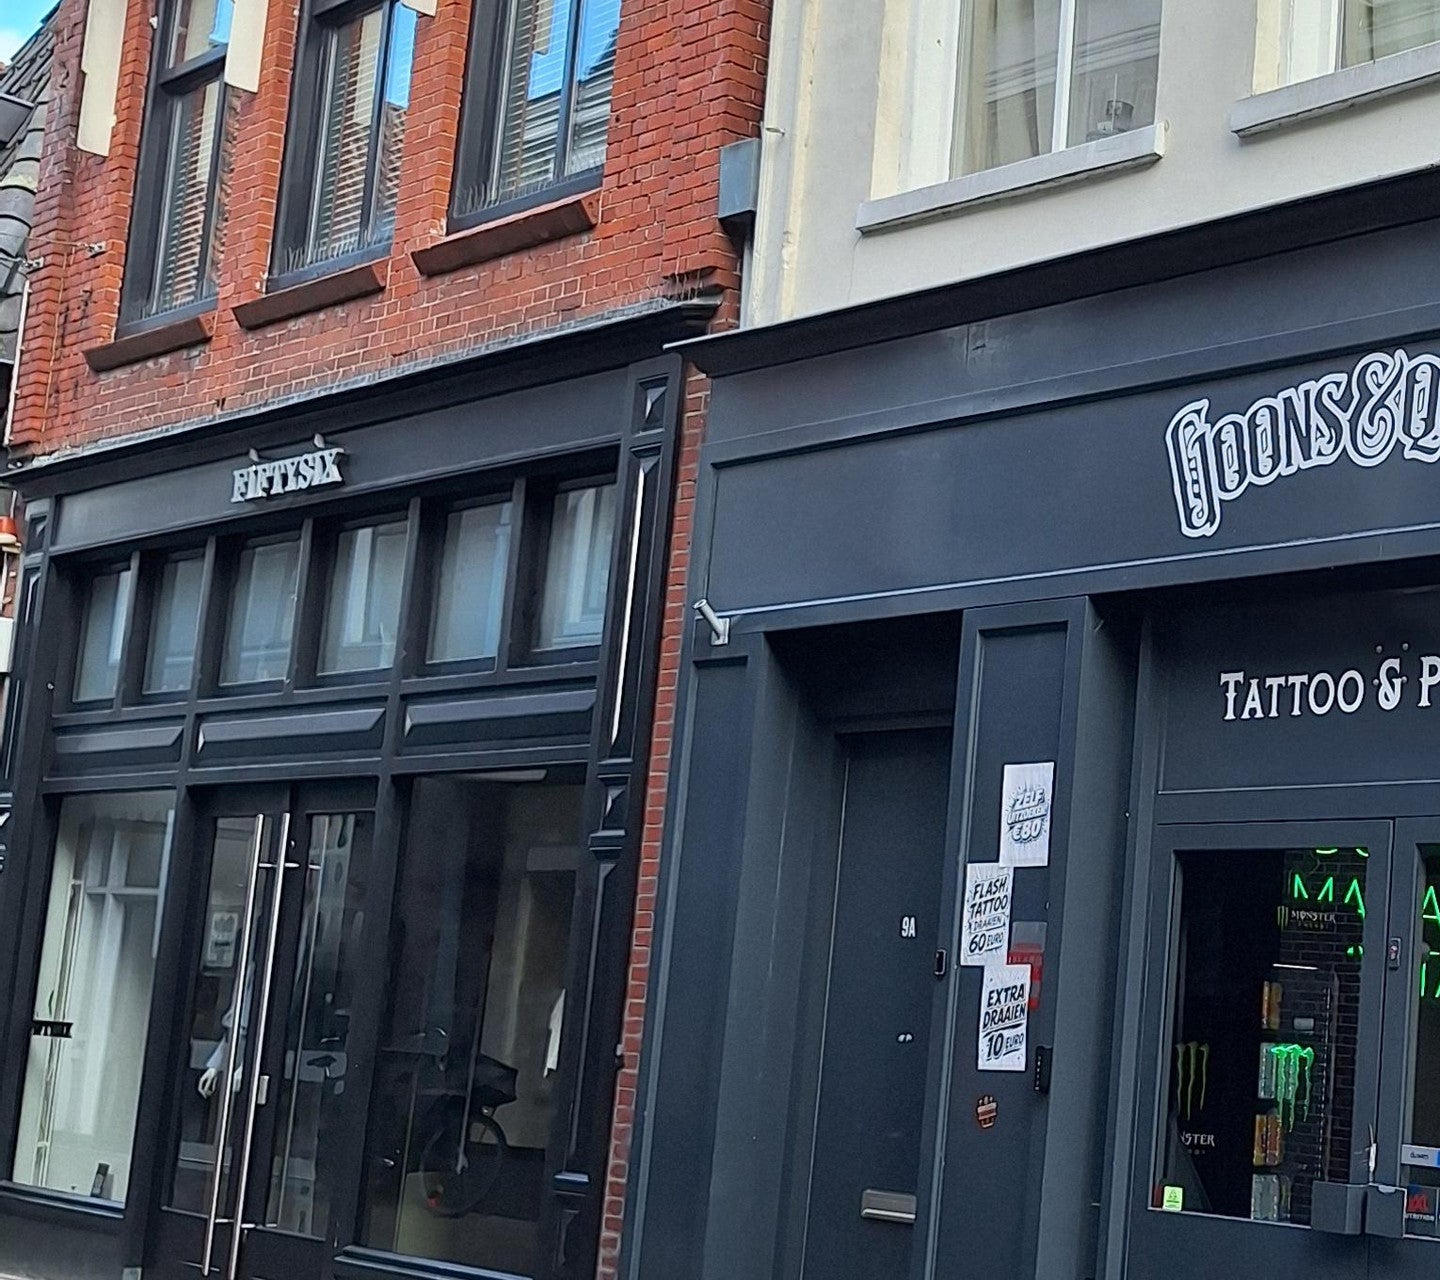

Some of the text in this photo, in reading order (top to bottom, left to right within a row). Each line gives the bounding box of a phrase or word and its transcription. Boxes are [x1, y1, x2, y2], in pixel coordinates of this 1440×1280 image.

[230, 448, 345, 502] FIFTYSIX
[1220, 671, 1364, 721] TATTOO
[1378, 658, 1408, 711] &
[973, 876, 1008, 901] FLASH
[969, 894, 1009, 920] TATTOO
[901, 916, 916, 938] 9A
[969, 932, 987, 953] 60
[987, 983, 1026, 1009] EXTRA
[983, 1003, 1027, 1028] DRAAIEN
[986, 1033, 1025, 1061] 10 EURO
